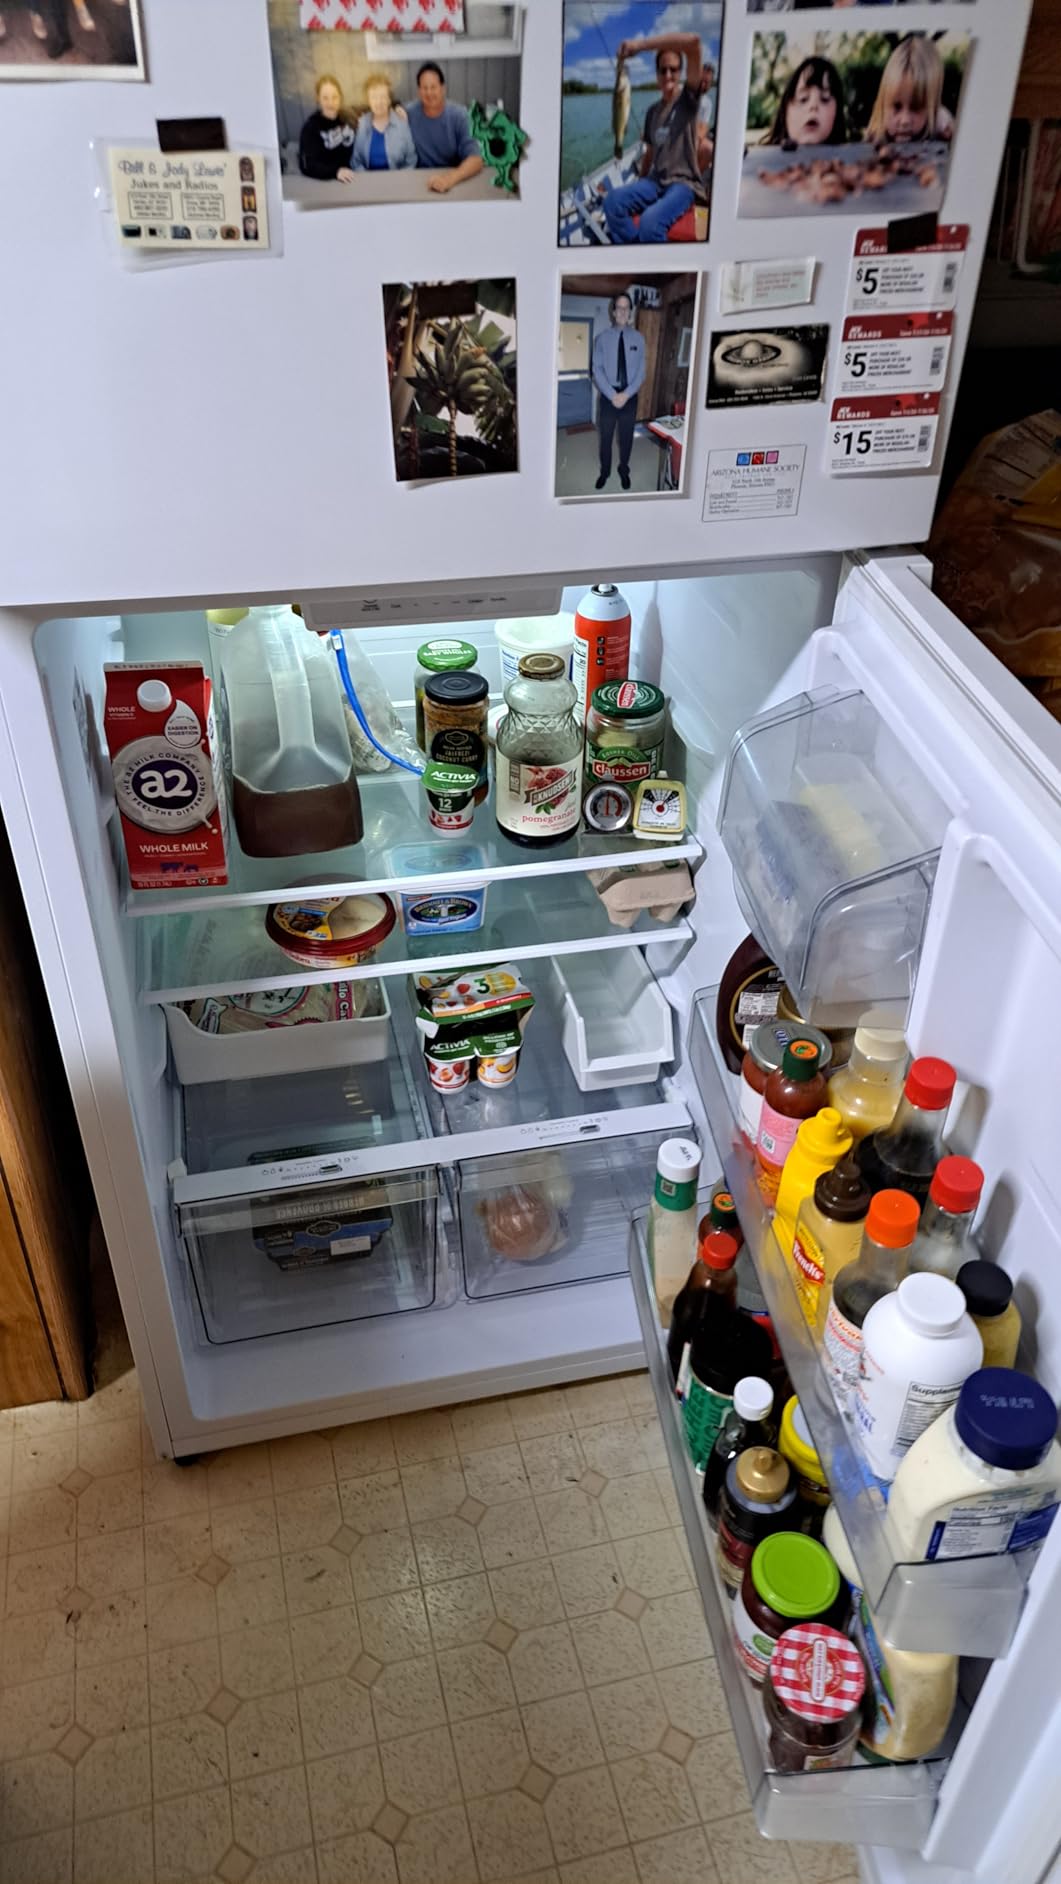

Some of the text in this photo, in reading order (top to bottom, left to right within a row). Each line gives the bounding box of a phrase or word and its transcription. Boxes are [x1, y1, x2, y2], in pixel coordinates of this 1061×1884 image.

[130, 179, 219, 190] Jukes and Radios
[855, 267, 879, 294] $5
[844, 352, 867, 377] $5
[833, 430, 872, 455] $15
[773, 463, 800, 472] SOCIETY
[134, 754, 155, 766] MILK
[158, 752, 201, 773] COMPANY
[431, 771, 476, 780] ACTIVIA
[595, 763, 647, 777] Claussen
[140, 769, 193, 799] a2
[133, 797, 153, 812] FEEL
[176, 776, 206, 816] DIFFERENCE
[438, 798, 452, 808] 12
[139, 841, 209, 854] WHOLE MILK
[430, 1039, 471, 1051] ACTIVIA
